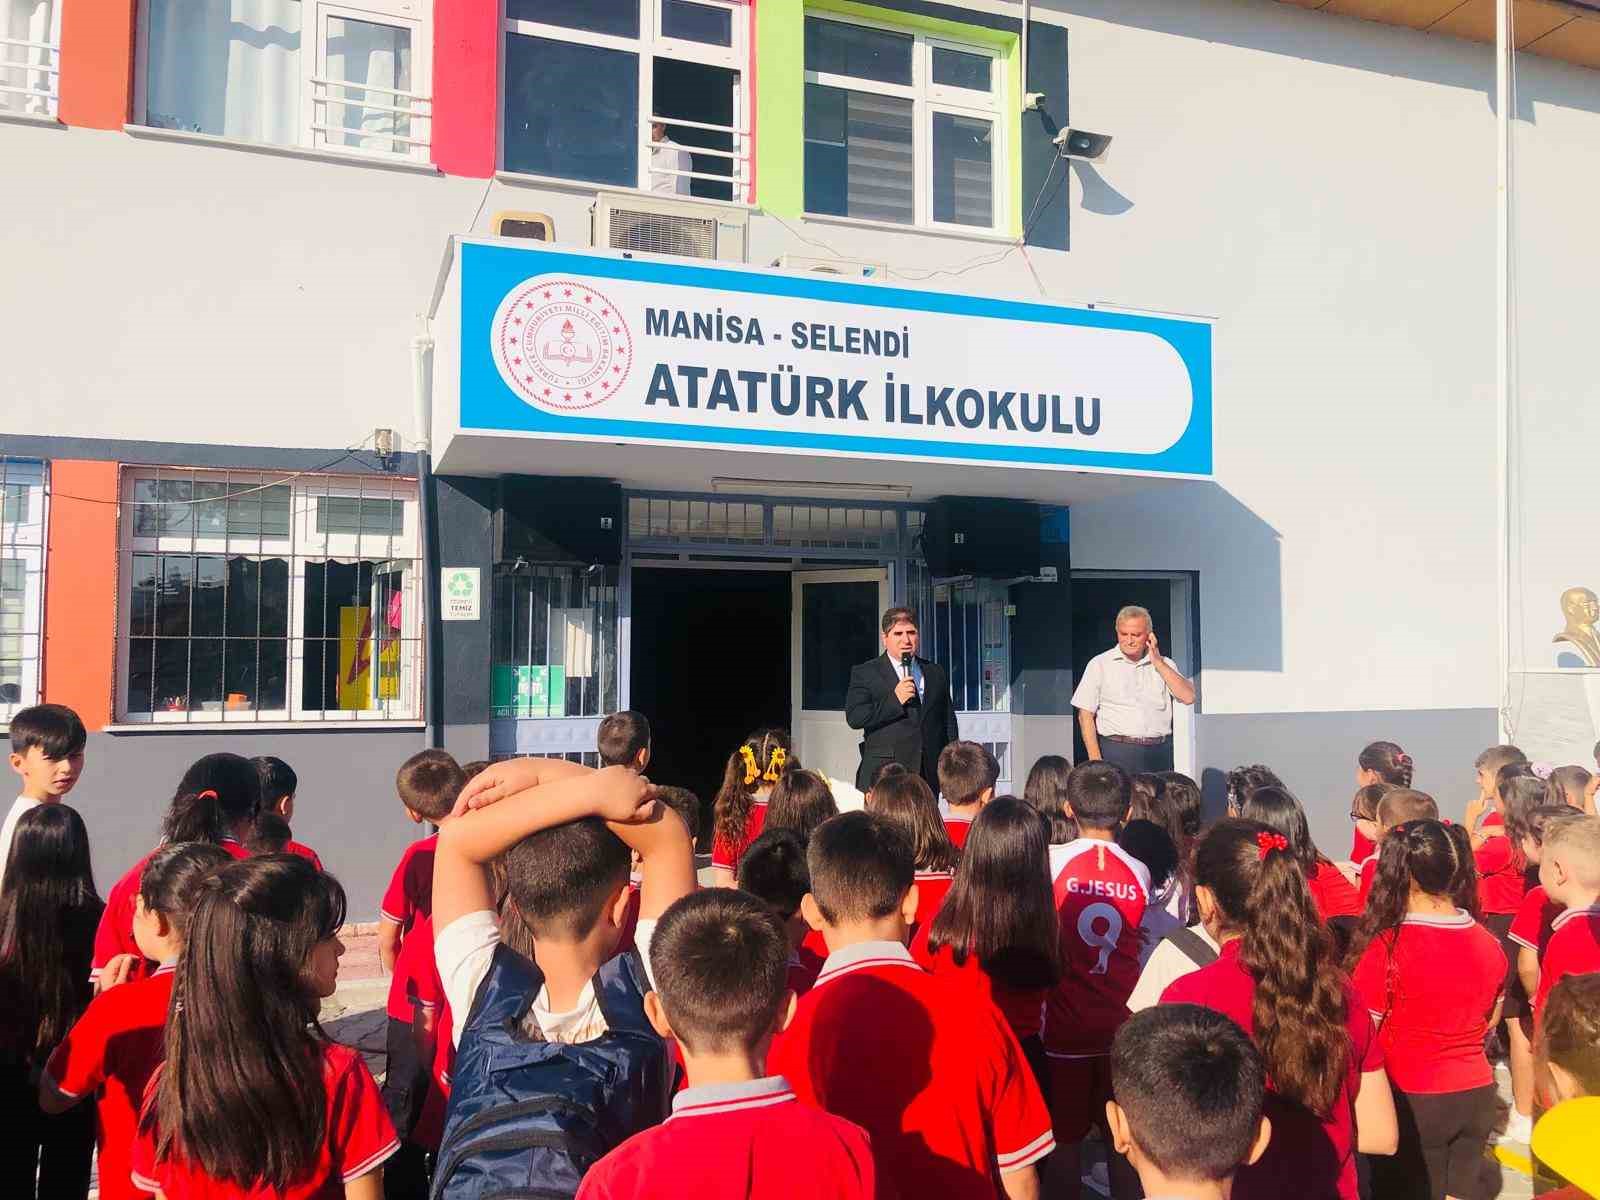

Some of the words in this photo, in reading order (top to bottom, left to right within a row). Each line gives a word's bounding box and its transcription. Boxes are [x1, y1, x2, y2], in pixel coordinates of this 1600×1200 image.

[645, 307, 764, 346] MANİSA
[791, 321, 910, 359] SELENDİ
[644, 363, 870, 421] ATATÜRK
[884, 371, 1102, 436] İLKOKULU
[1066, 877, 1137, 900] G.JESUS
[1077, 902, 1123, 975] 9
